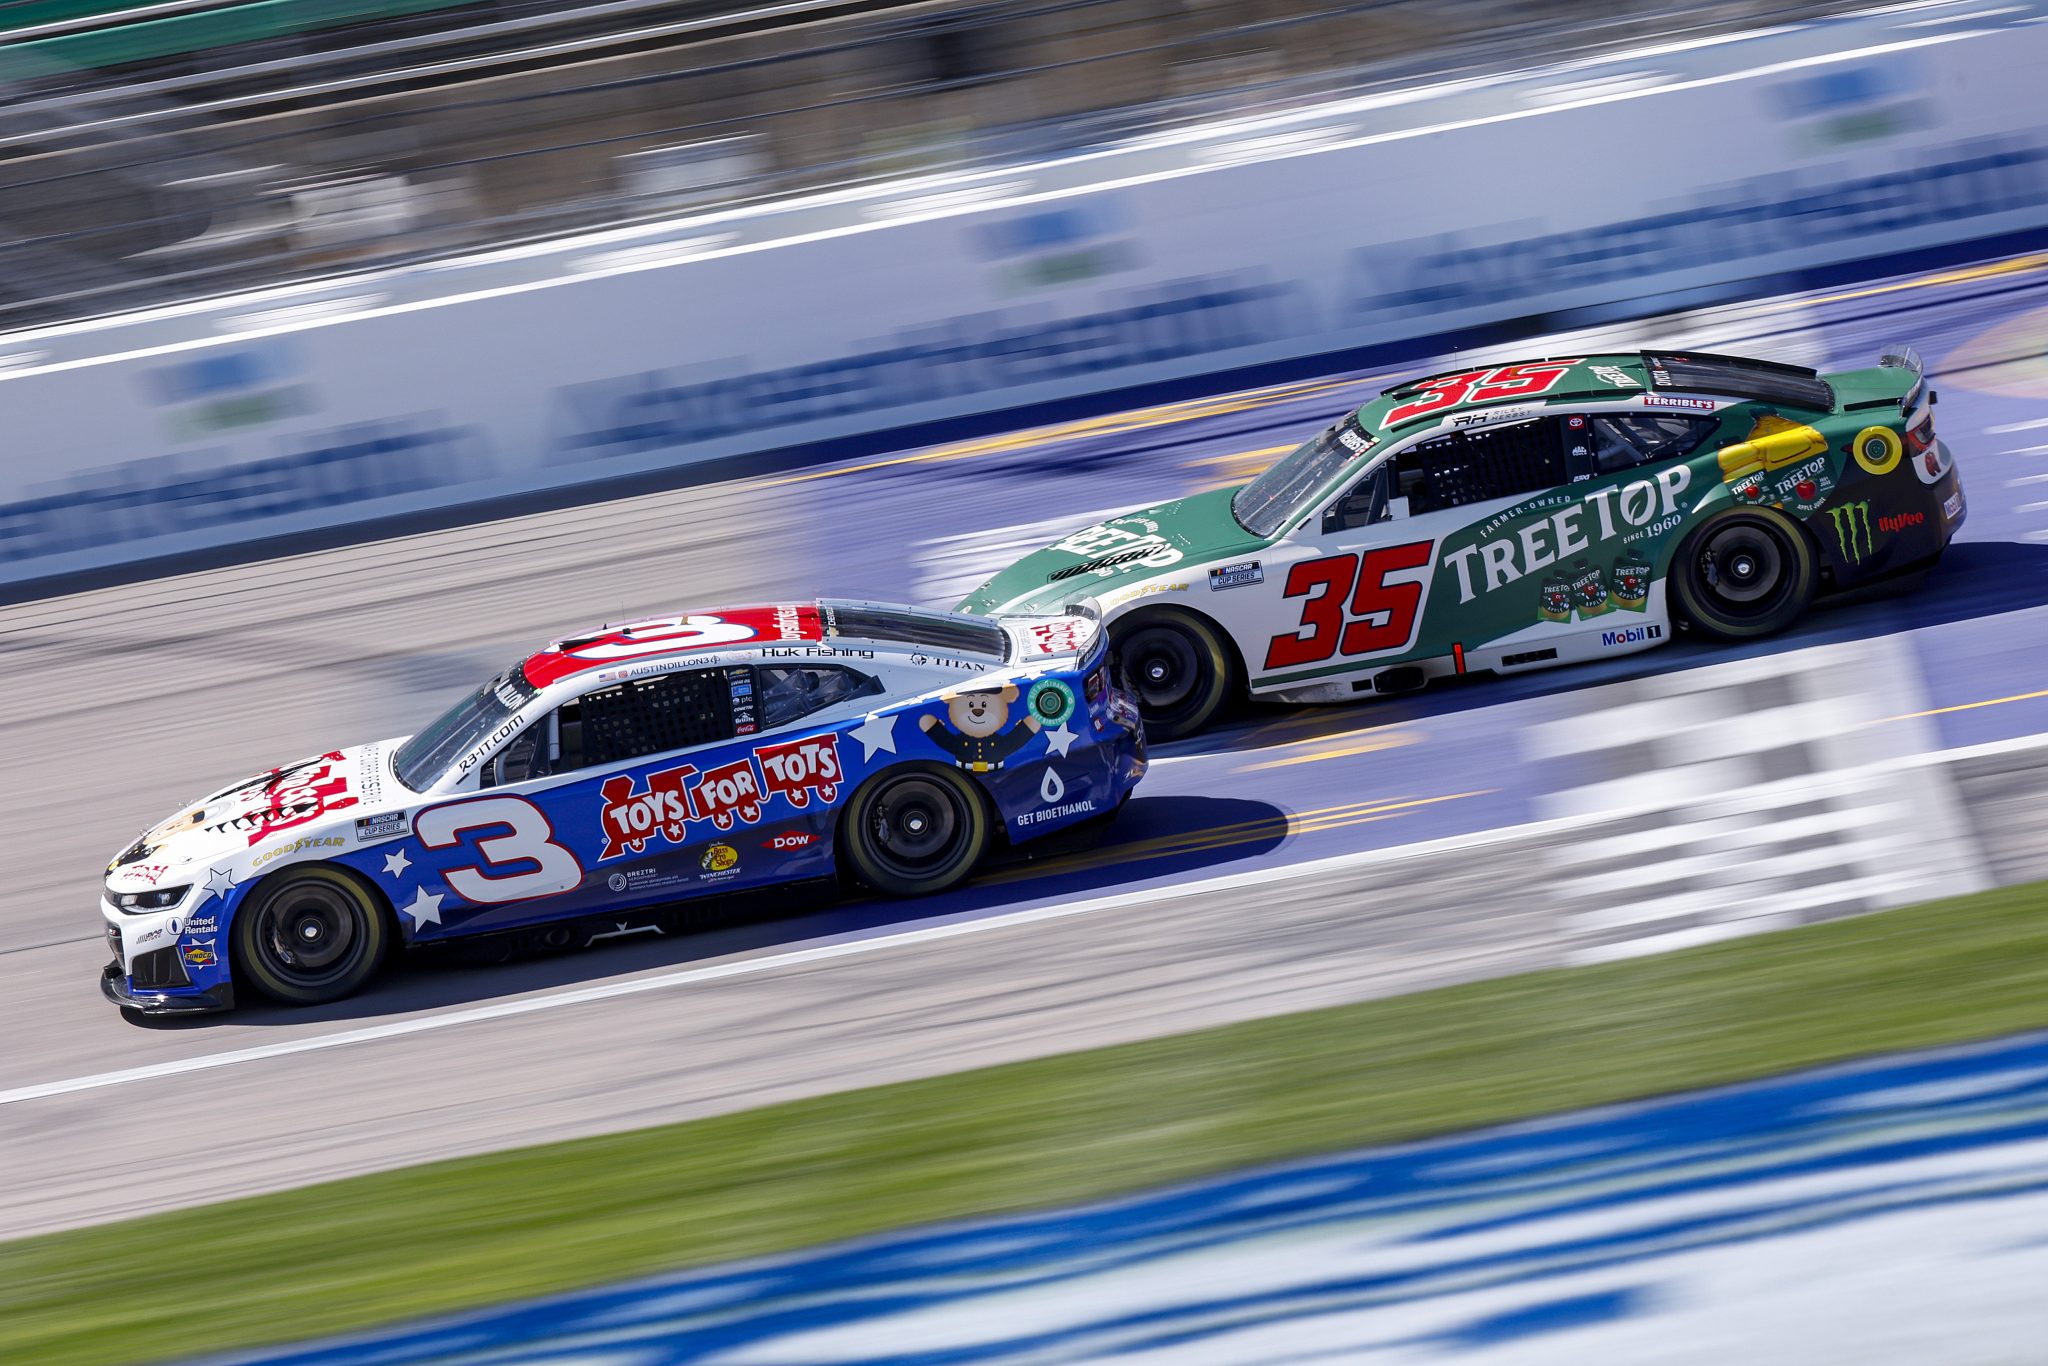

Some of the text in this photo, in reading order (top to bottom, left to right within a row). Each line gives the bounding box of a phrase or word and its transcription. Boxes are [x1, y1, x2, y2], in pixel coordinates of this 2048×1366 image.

[1379, 358, 1587, 431] 35
[1645, 397, 1713, 409] TERRIBLE'S
[1491, 410, 1533, 421] HERBST
[1480, 495, 1571, 539] FARMER-OWNED
[1623, 515, 1682, 544] SINCE 1960
[1225, 563, 1253, 574] NASCAR
[1218, 572, 1255, 585] CUP SERIES
[1263, 539, 1435, 671] 35
[1602, 628, 1645, 646] Mobil
[762, 648, 874, 659] Huk Fishing
[934, 657, 986, 672] TITAN
[610, 743, 836, 835] TOYS FOR TOTS
[371, 813, 399, 825] NASCAR
[1017, 800, 1096, 826] GET BIOETHANOL
[364, 823, 401, 836] CUP SERIES
[774, 835, 809, 849] DOW
[252, 836, 345, 867] GOODYEAR
[412, 793, 585, 905] 3
[627, 868, 656, 878] BREZTRI
[699, 867, 741, 880] WINCHESTER
[184, 916, 215, 926] United
[185, 925, 218, 934] Rentals
